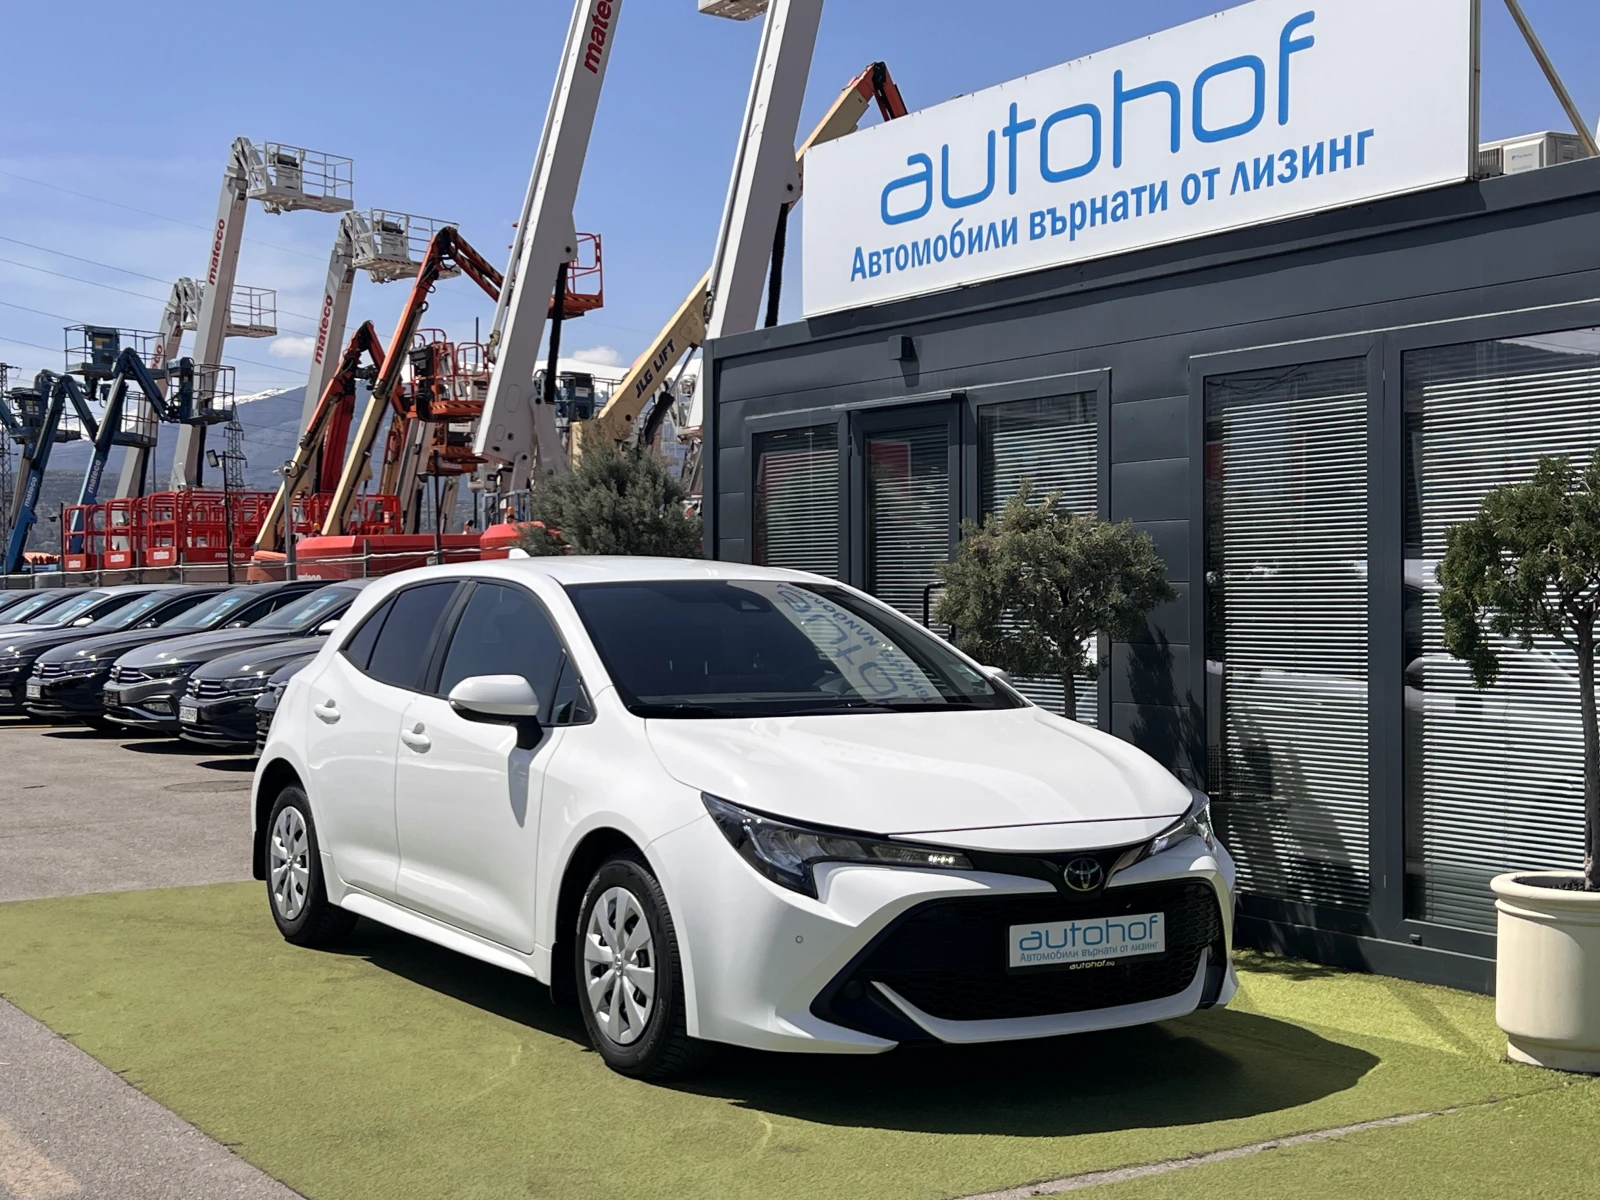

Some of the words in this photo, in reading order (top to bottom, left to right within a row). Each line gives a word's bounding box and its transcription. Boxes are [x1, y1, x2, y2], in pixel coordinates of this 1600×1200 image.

[880, 10, 1315, 226] autohof
[850, 218, 1018, 282] Автомобили
[1029, 180, 1168, 241] върнати
[1181, 167, 1220, 206] от
[1230, 128, 1374, 196] лизинг
[208, 218, 225, 286] mateco
[314, 294, 333, 365] mateco
[635, 368, 654, 399] JLG
[653, 338, 676, 373] LIFT
[24, 476, 38, 507] mateco
[88, 459, 102, 494] mateco
[1019, 914, 1158, 951] autohof
[1019, 949, 1079, 963] Автомобили
[1081, 945, 1118, 959] върнати
[1131, 941, 1159, 952] лизинг
[1069, 959, 1116, 970] autohof.bg
